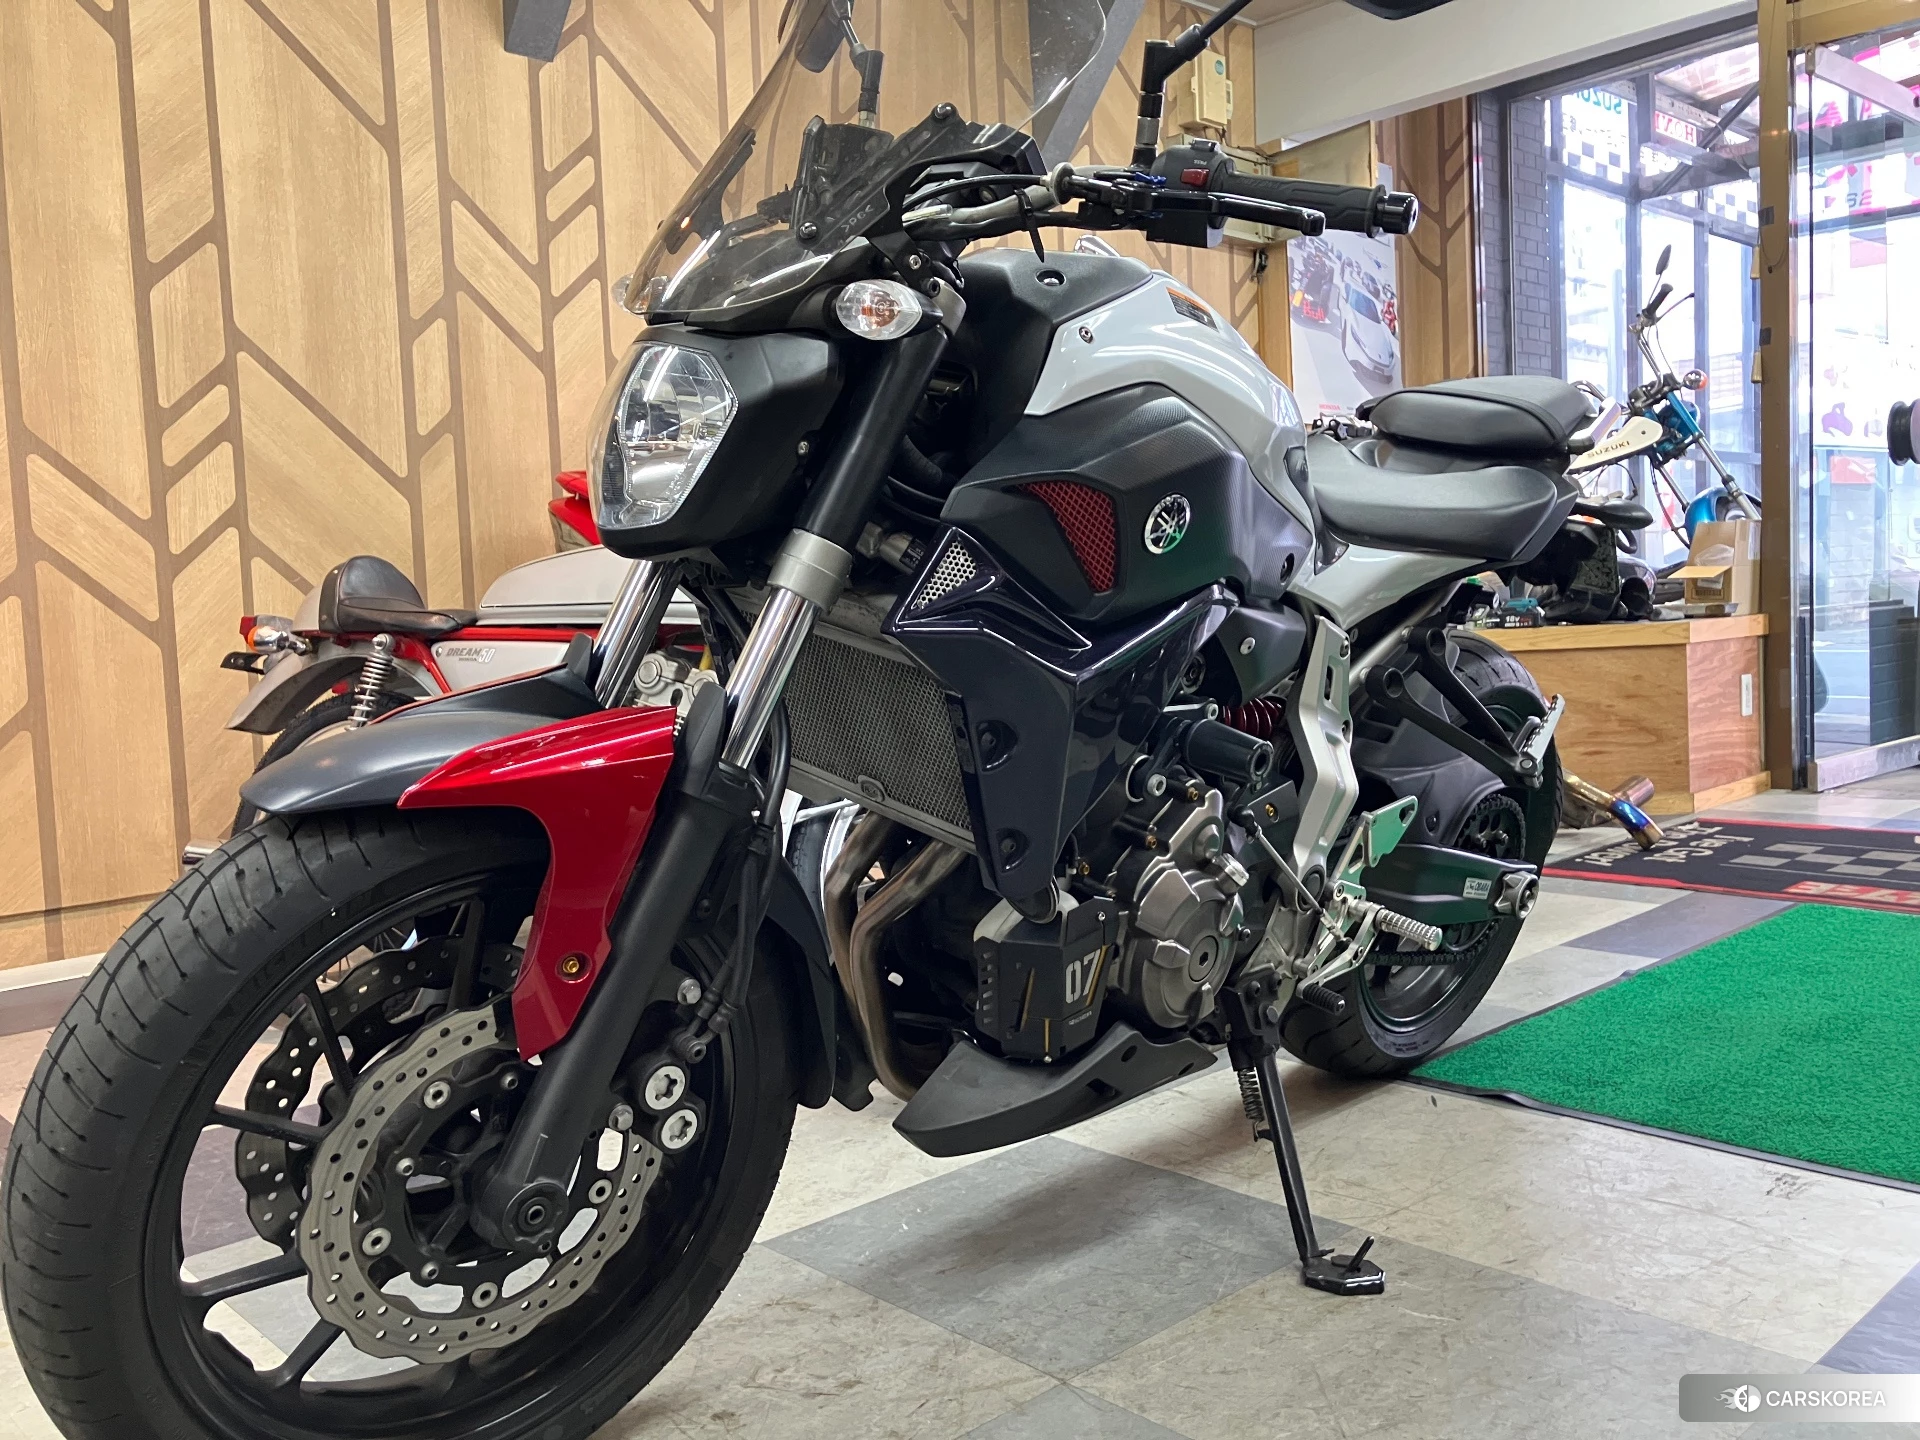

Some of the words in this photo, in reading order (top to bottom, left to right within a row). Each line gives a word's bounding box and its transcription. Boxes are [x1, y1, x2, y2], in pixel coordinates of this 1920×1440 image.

[1587, 440, 1630, 458] SUZUKI
[446, 647, 482, 657] DREAM
[478, 648, 496, 663] 50
[1065, 948, 1101, 1004] 07
